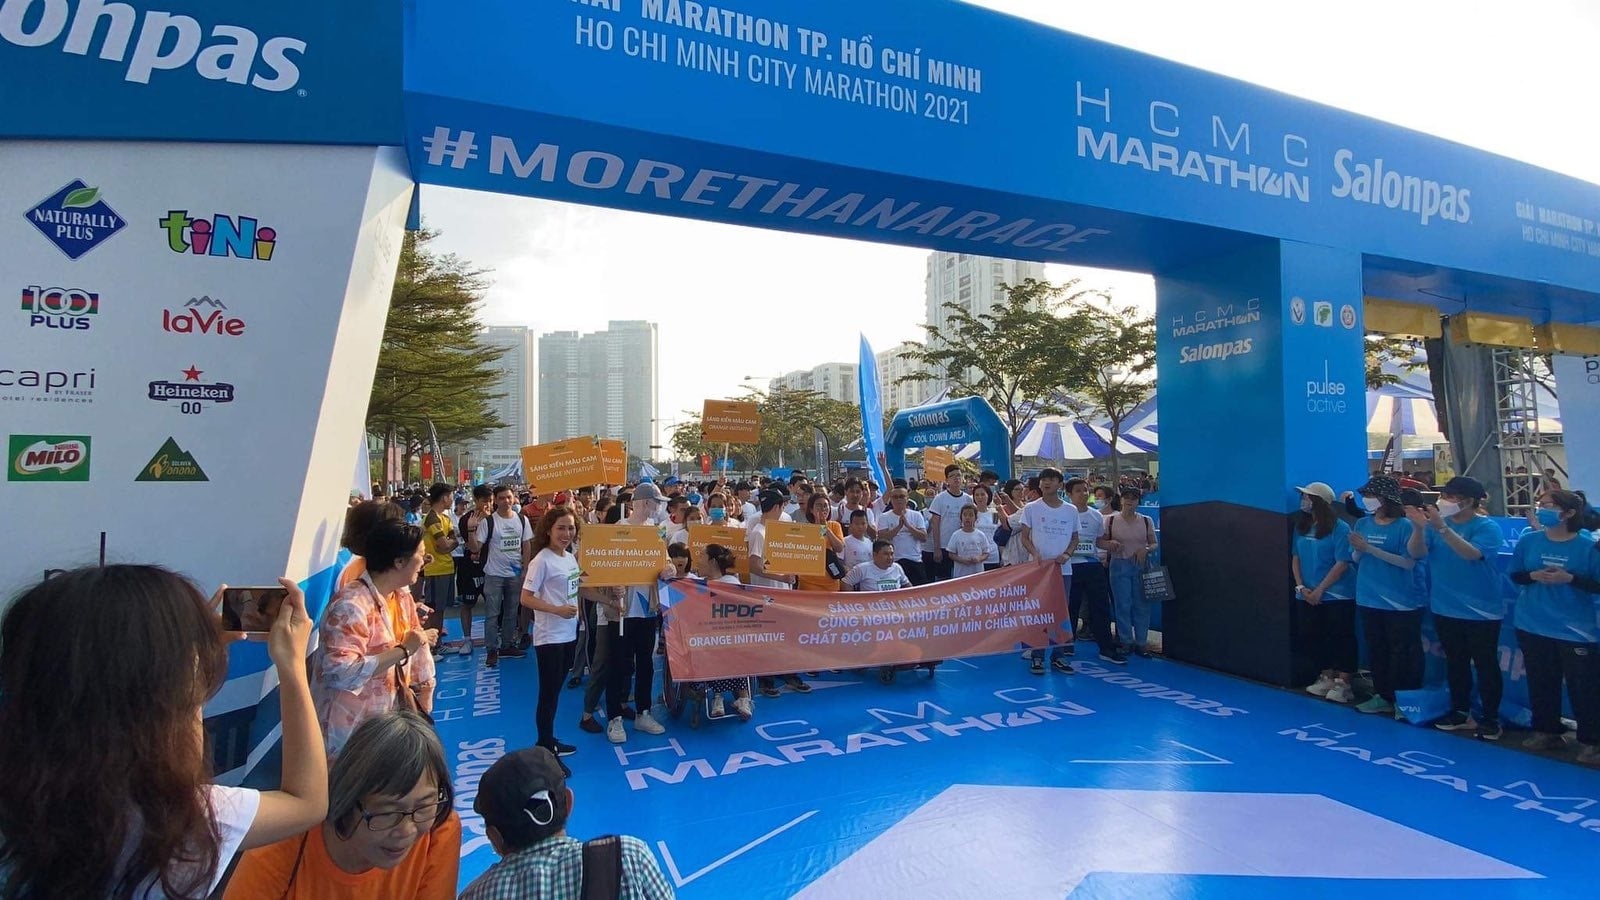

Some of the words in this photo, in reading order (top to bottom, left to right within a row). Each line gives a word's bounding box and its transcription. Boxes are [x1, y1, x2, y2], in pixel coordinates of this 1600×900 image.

[641, 0, 789, 51] MARATHON
[797, 27, 832, 62] TP.
[840, 34, 873, 70] HỒ
[881, 47, 921, 81] CHÍ
[927, 58, 982, 94] MINH
[575, 15, 613, 50] HO
[624, 27, 667, 63] CHI
[677, 38, 739, 78] MINH
[748, 54, 797, 90] CITY
[804, 66, 917, 114] MARATHON
[924, 92, 969, 125] 2021
[421, 126, 1112, 252] #MORETHANARACE
[1331, 148, 1471, 226] Salonpas
[34, 208, 118, 230] NATURALLY
[56, 223, 94, 241] PLUS
[27, 285, 92, 316] 100
[30, 314, 91, 330] PLUS
[1179, 338, 1253, 364] Salonpas
[1306, 359, 1346, 396] pulse
[153, 384, 229, 398] Heineken
[181, 401, 202, 415] 0.0
[1307, 399, 1346, 414] active
[908, 410, 950, 427] Salonpas
[913, 434, 928, 443] COOL
[929, 432, 948, 442] DOWN
[949, 430, 966, 439] AREA
[25, 450, 80, 466] MILO
[529, 464, 548, 473] SÁNG
[536, 471, 562, 480] ORANGE
[563, 465, 594, 476] INITIATIVE
[585, 547, 606, 556] SÁNG
[608, 547, 625, 556] KIẾN
[626, 548, 643, 556] MÀU
[769, 541, 783, 549] SÁNG
[590, 560, 621, 568] ORANGE
[622, 560, 657, 568] INITIATIVE
[828, 600, 865, 613] SÁNG
[868, 598, 896, 612] KIẾN
[899, 595, 928, 609] MÀU
[930, 592, 960, 606] CAM
[1000, 584, 1027, 597] HÀNH
[711, 603, 764, 619] HPDF
[818, 614, 860, 628] CÙNG
[954, 604, 971, 619] TẬT
[975, 605, 982, 616] &
[985, 604, 1007, 617] NẠN
[798, 628, 838, 645] CHẤT
[841, 629, 872, 646] ĐỘC
[876, 630, 894, 641] DA
[898, 626, 929, 640] CAM,
[932, 622, 959, 636] BOM
[961, 619, 982, 633] MÌN
[985, 613, 1018, 630] CHIẾN
[1019, 612, 1055, 627] TRANH
[689, 635, 732, 647] ORANGE
[734, 631, 785, 645] INITIATIVE
